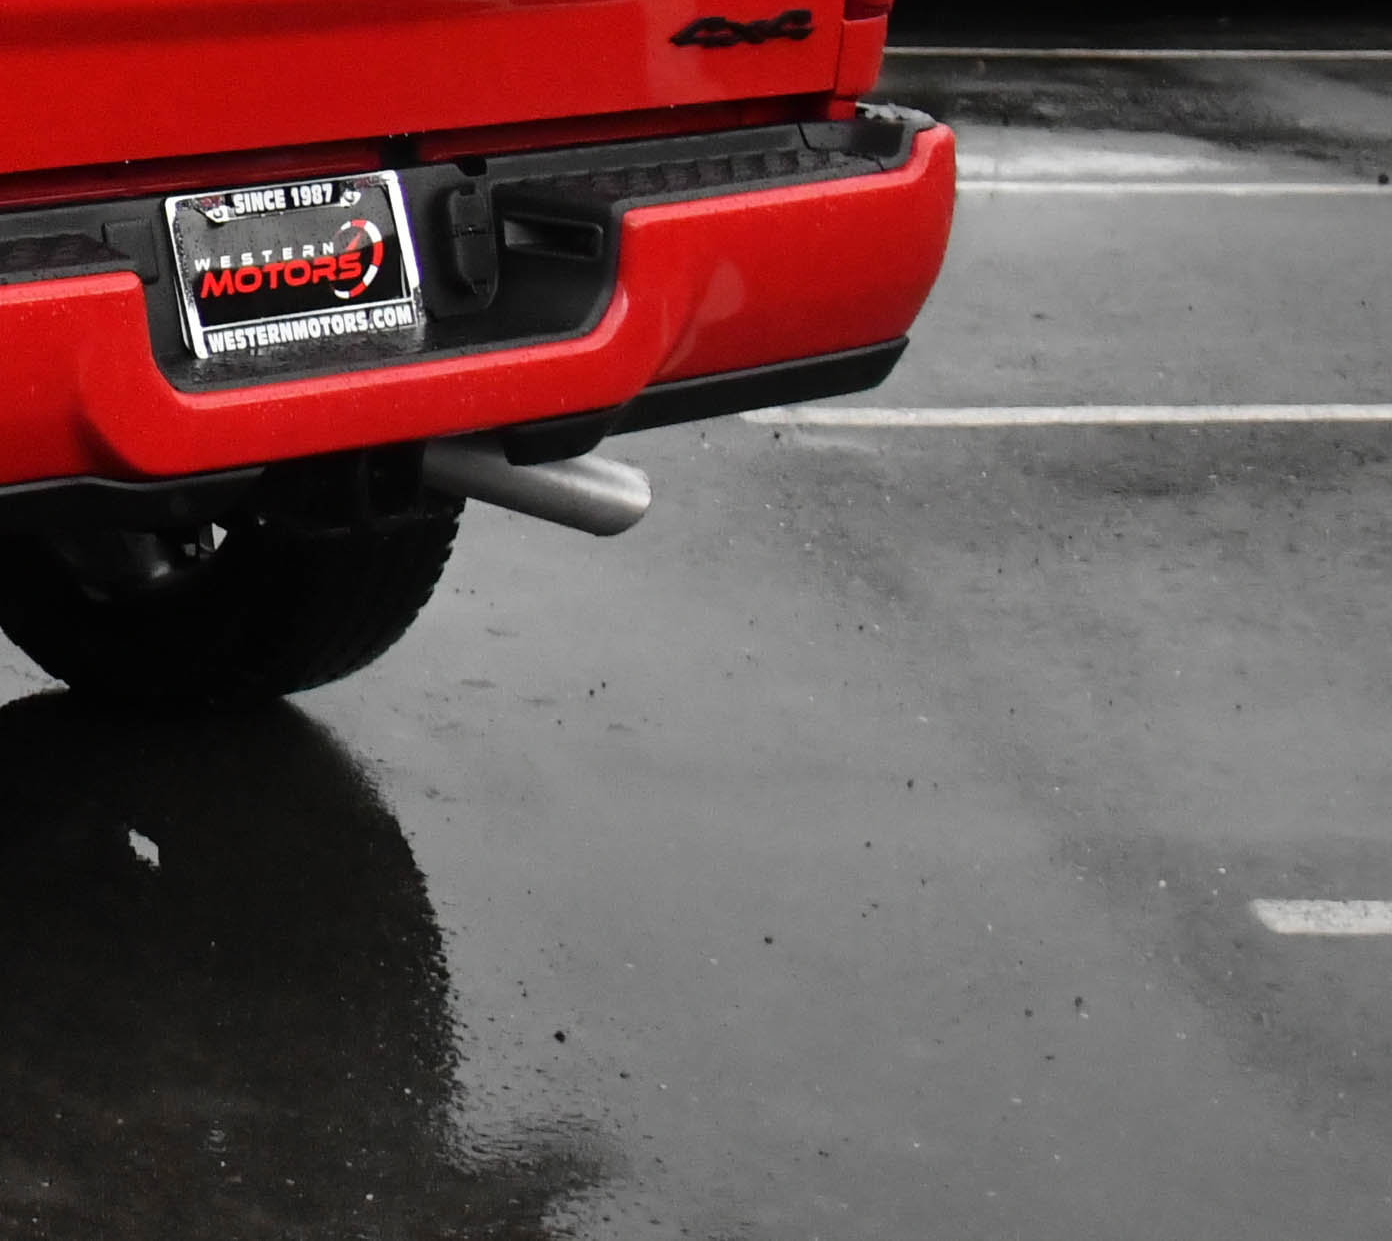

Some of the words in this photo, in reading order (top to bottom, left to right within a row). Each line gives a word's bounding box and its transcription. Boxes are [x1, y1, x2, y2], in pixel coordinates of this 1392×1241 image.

[232, 189, 287, 215] SINCE
[291, 184, 333, 208] 1987
[195, 241, 335, 271] WESTERN
[200, 251, 362, 299] MOTORS
[208, 304, 413, 354] WESTERNMOTORS.COM
